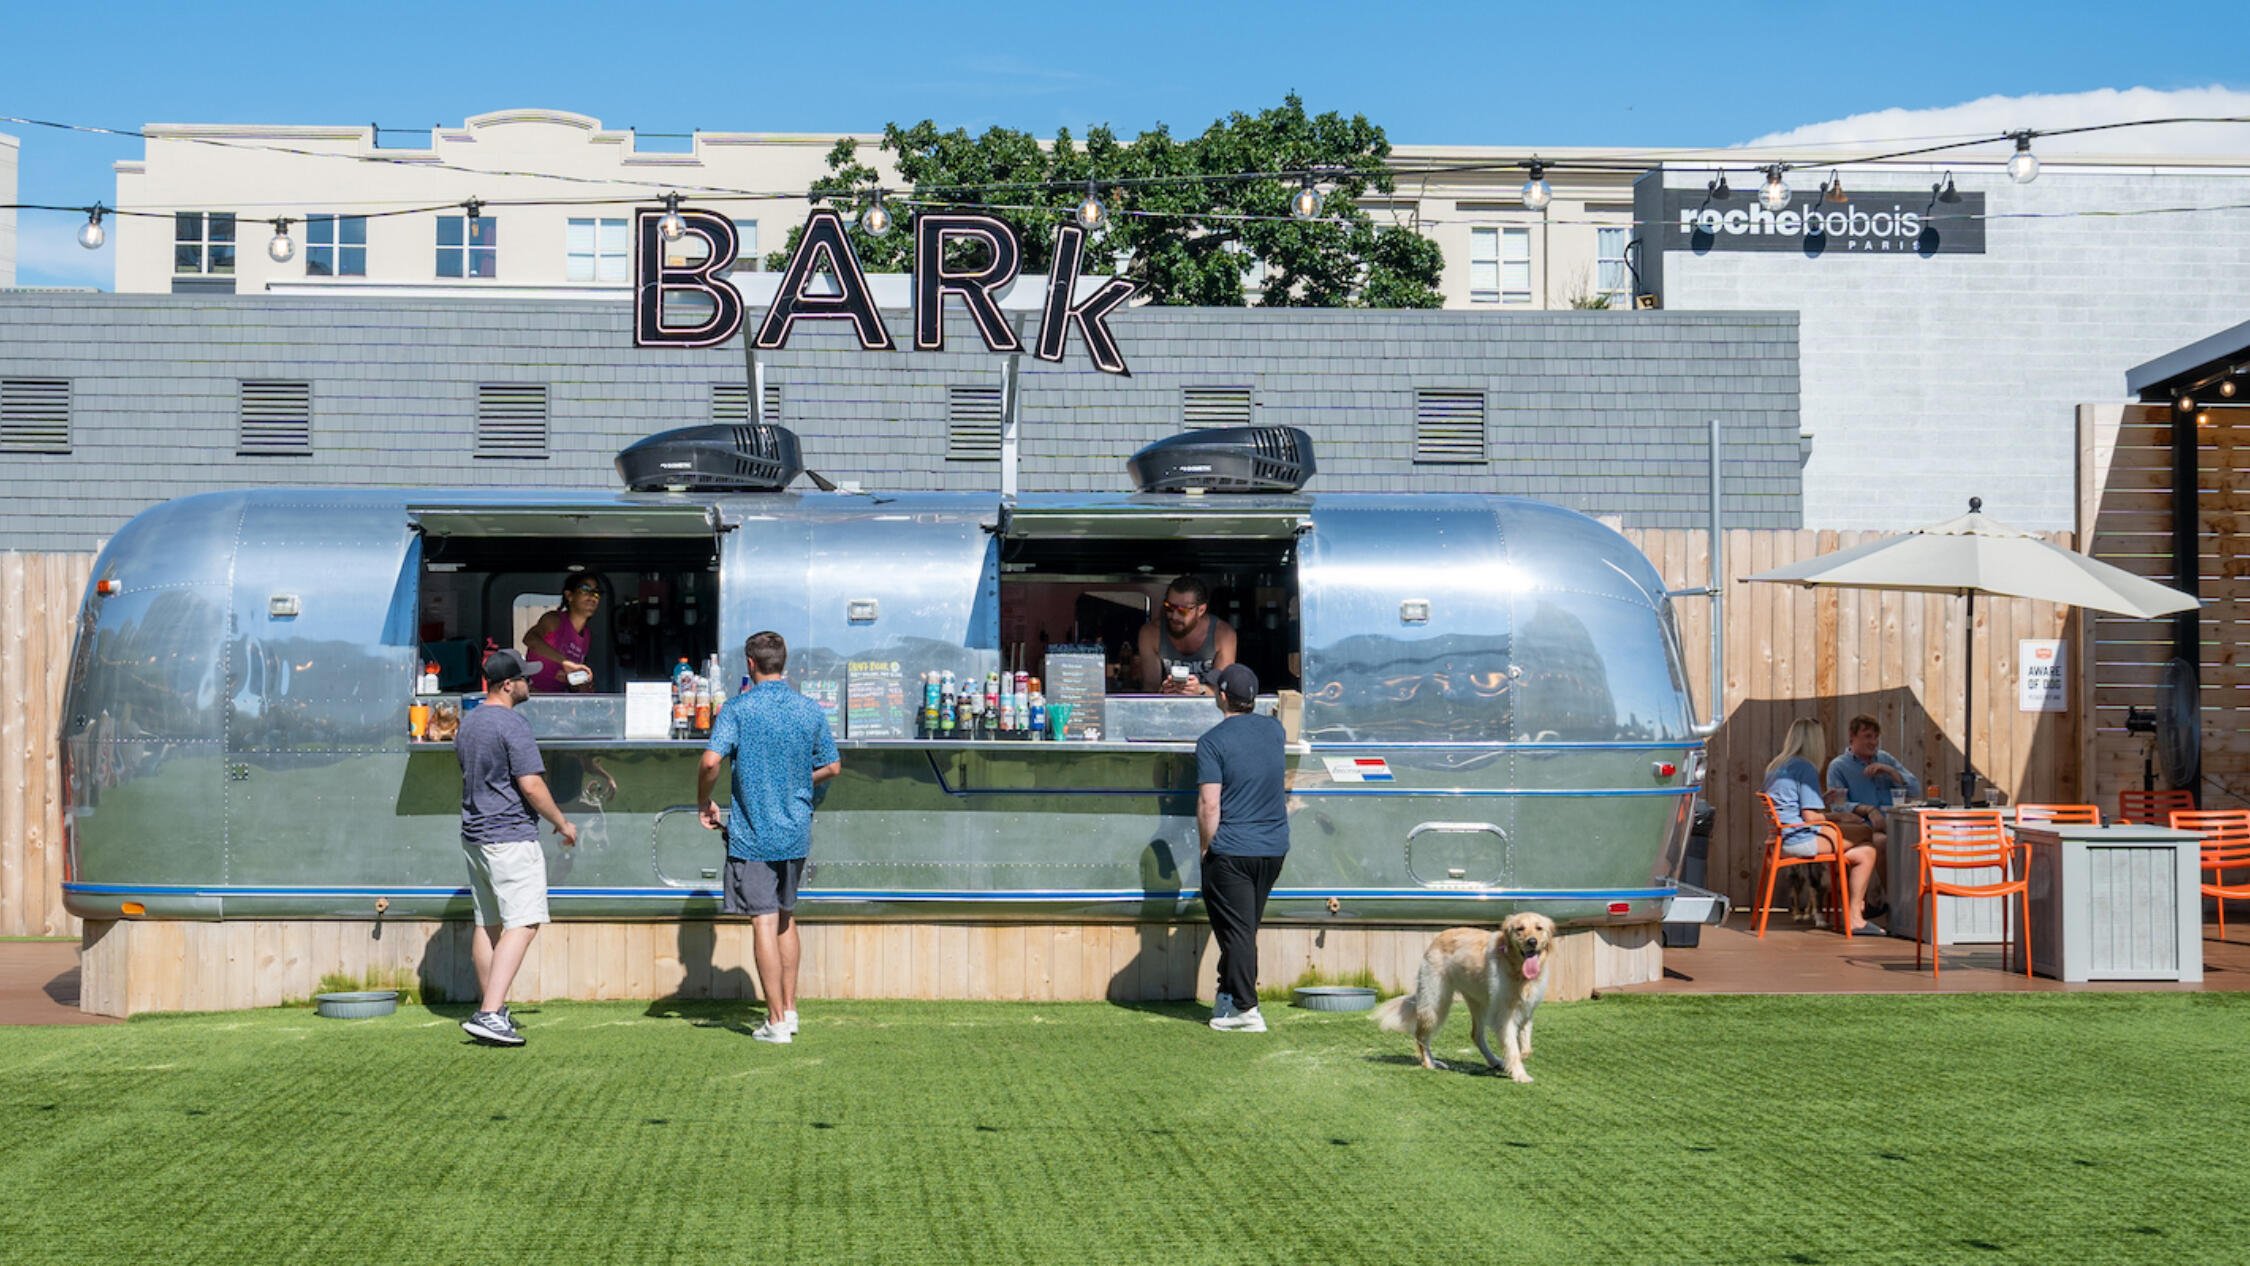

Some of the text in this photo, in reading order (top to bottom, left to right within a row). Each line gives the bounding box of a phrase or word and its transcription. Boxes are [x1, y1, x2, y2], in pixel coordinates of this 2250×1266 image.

[1848, 240, 1920, 250] PARIS
[2028, 666, 2061, 676] AWARE
[2028, 679, 2061, 690] OF DOG
